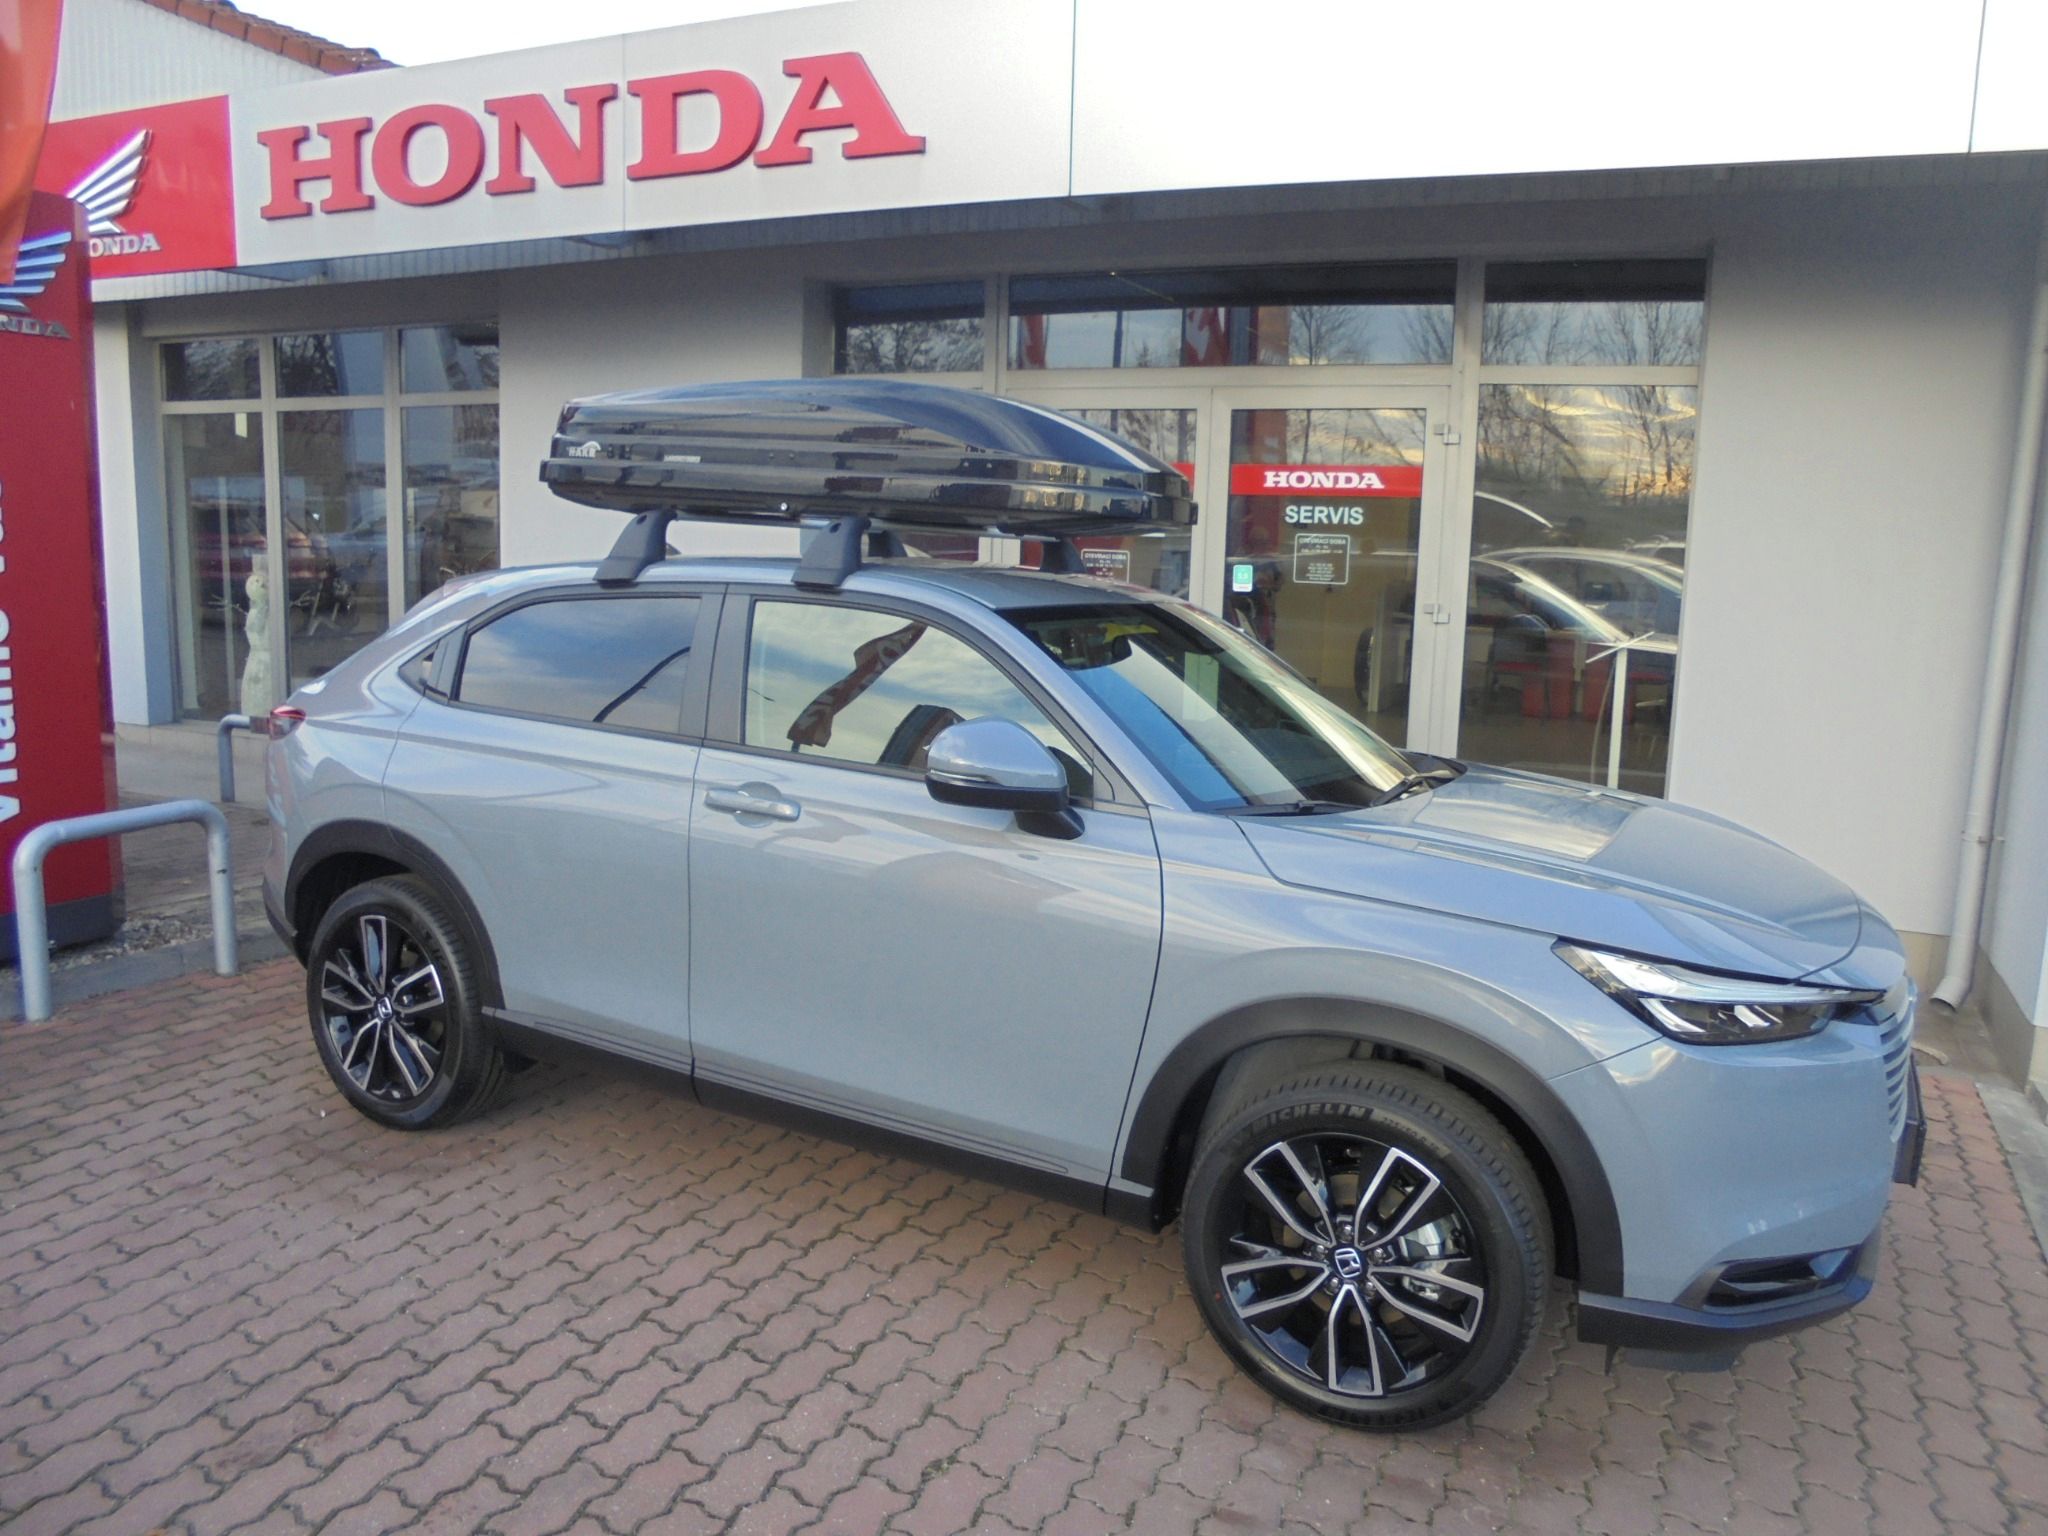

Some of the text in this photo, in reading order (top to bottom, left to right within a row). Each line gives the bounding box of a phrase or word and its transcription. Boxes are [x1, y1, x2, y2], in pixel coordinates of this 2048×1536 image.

[257, 51, 926, 221] HONDA
[89, 234, 161, 257] ONDA
[0, 315, 71, 339] NDA
[1263, 470, 1385, 489] HONDA
[1284, 505, 1364, 525] SERVIS
